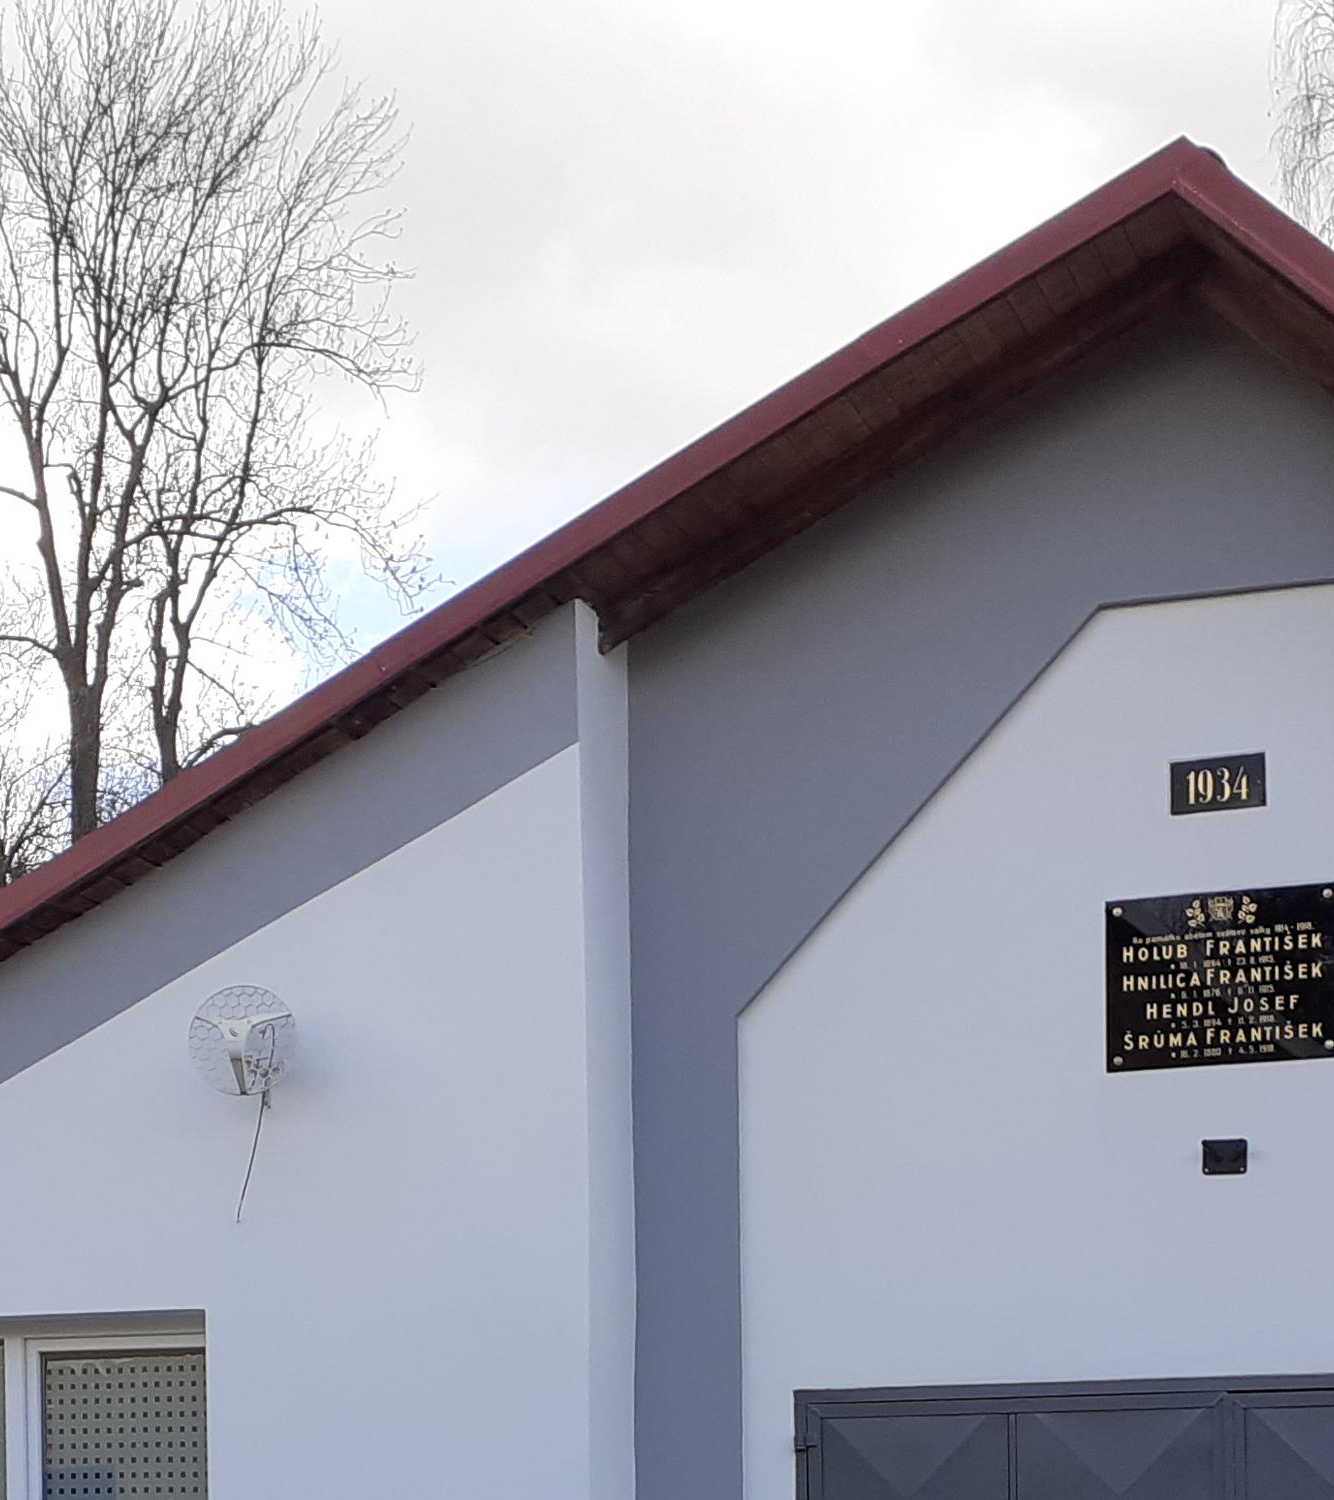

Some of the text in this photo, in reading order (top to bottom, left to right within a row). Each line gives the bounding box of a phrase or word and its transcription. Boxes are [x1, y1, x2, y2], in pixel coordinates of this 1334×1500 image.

[1185, 766, 1250, 805] 1934
[1122, 930, 1323, 963] HOLUB FRANTIŠEK
[1122, 960, 1323, 992] HNILICA FRANTIŠEK
[1146, 994, 1299, 1020] HENDL JOSEF
[1123, 1020, 1323, 1050] ŠRŮMA FRANTIŠEK
